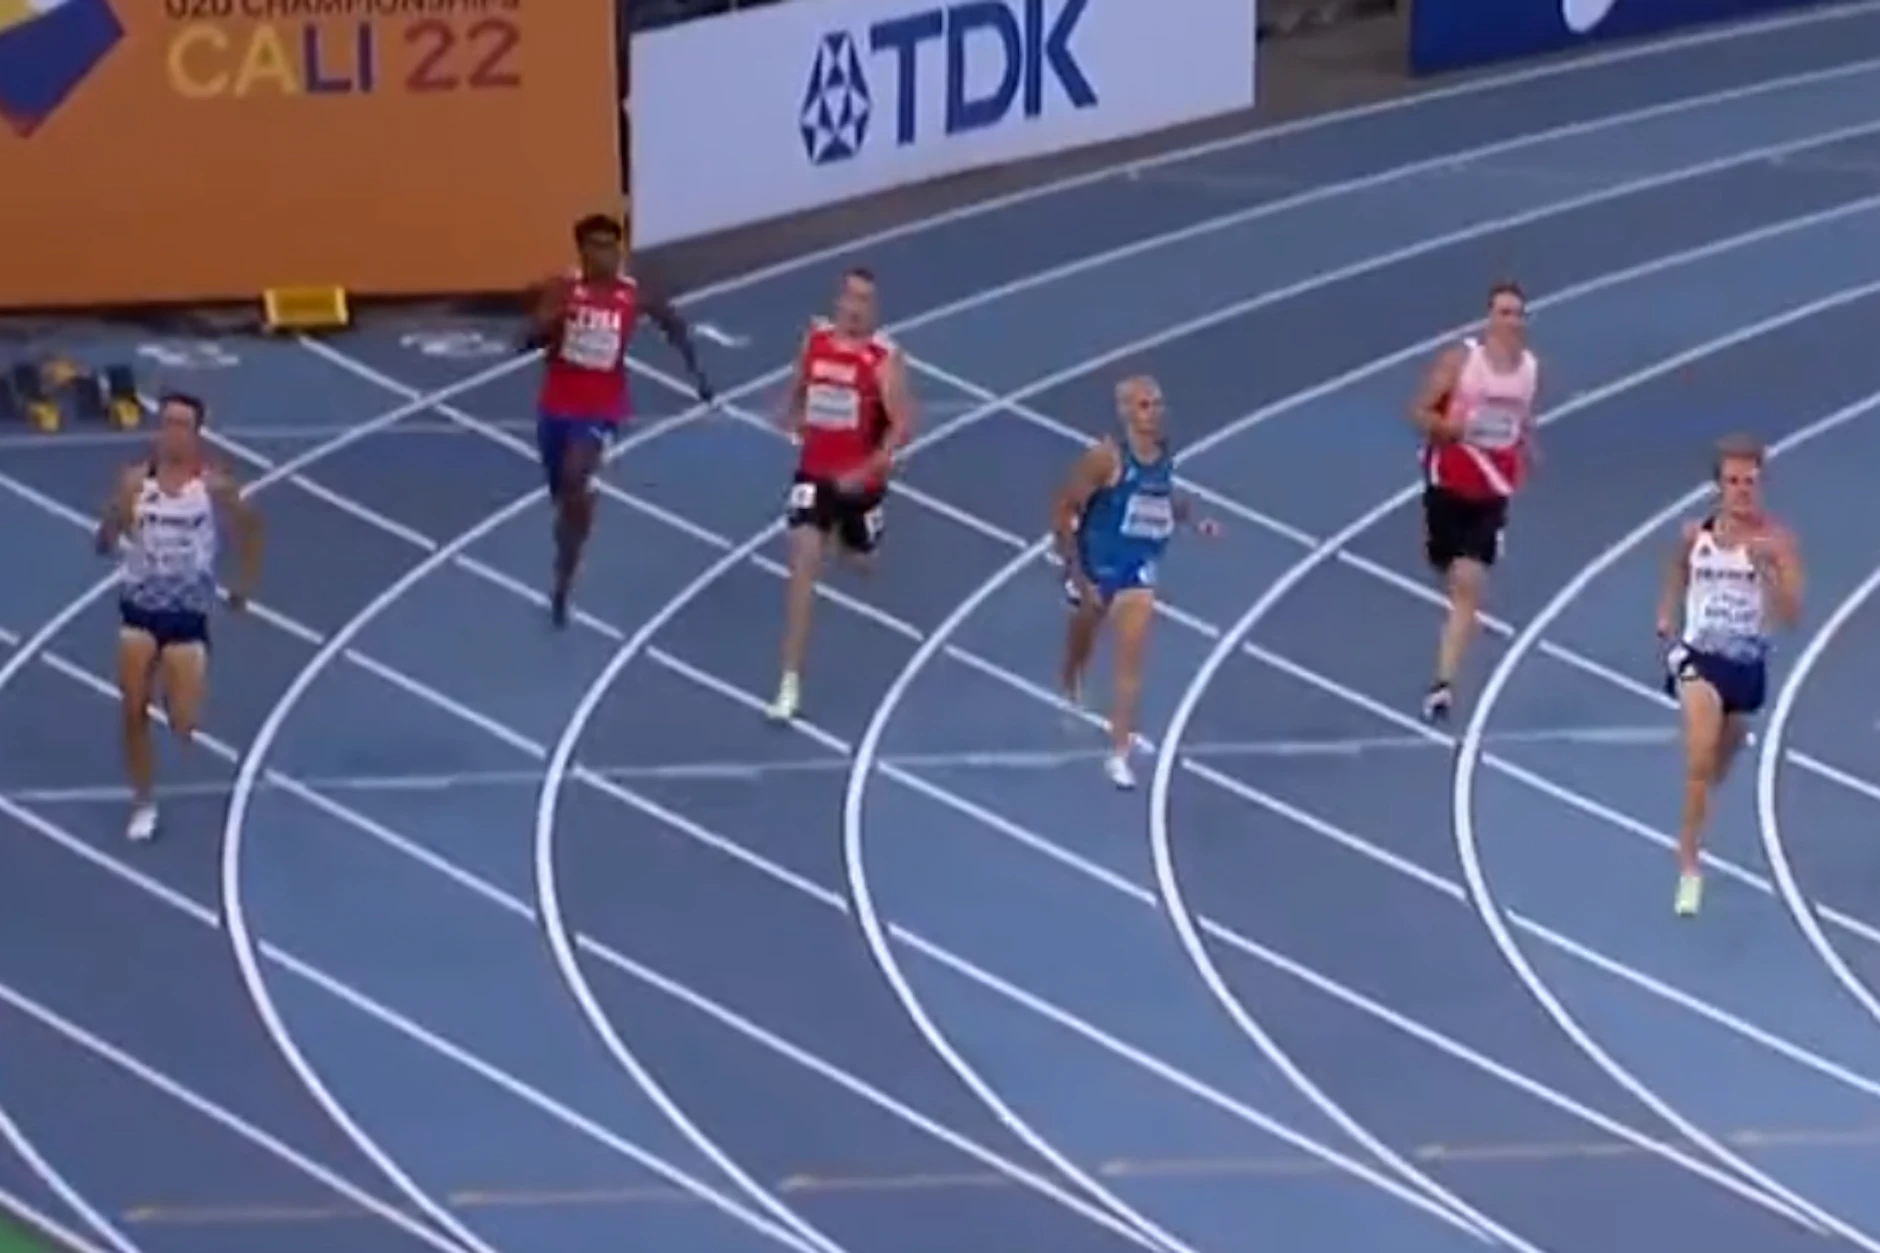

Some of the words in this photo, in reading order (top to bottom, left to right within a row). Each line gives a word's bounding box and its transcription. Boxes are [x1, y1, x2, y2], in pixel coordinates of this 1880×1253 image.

[167, 22, 374, 97] CALI
[404, 18, 521, 93] 22
[869, 0, 1098, 145] TDK
